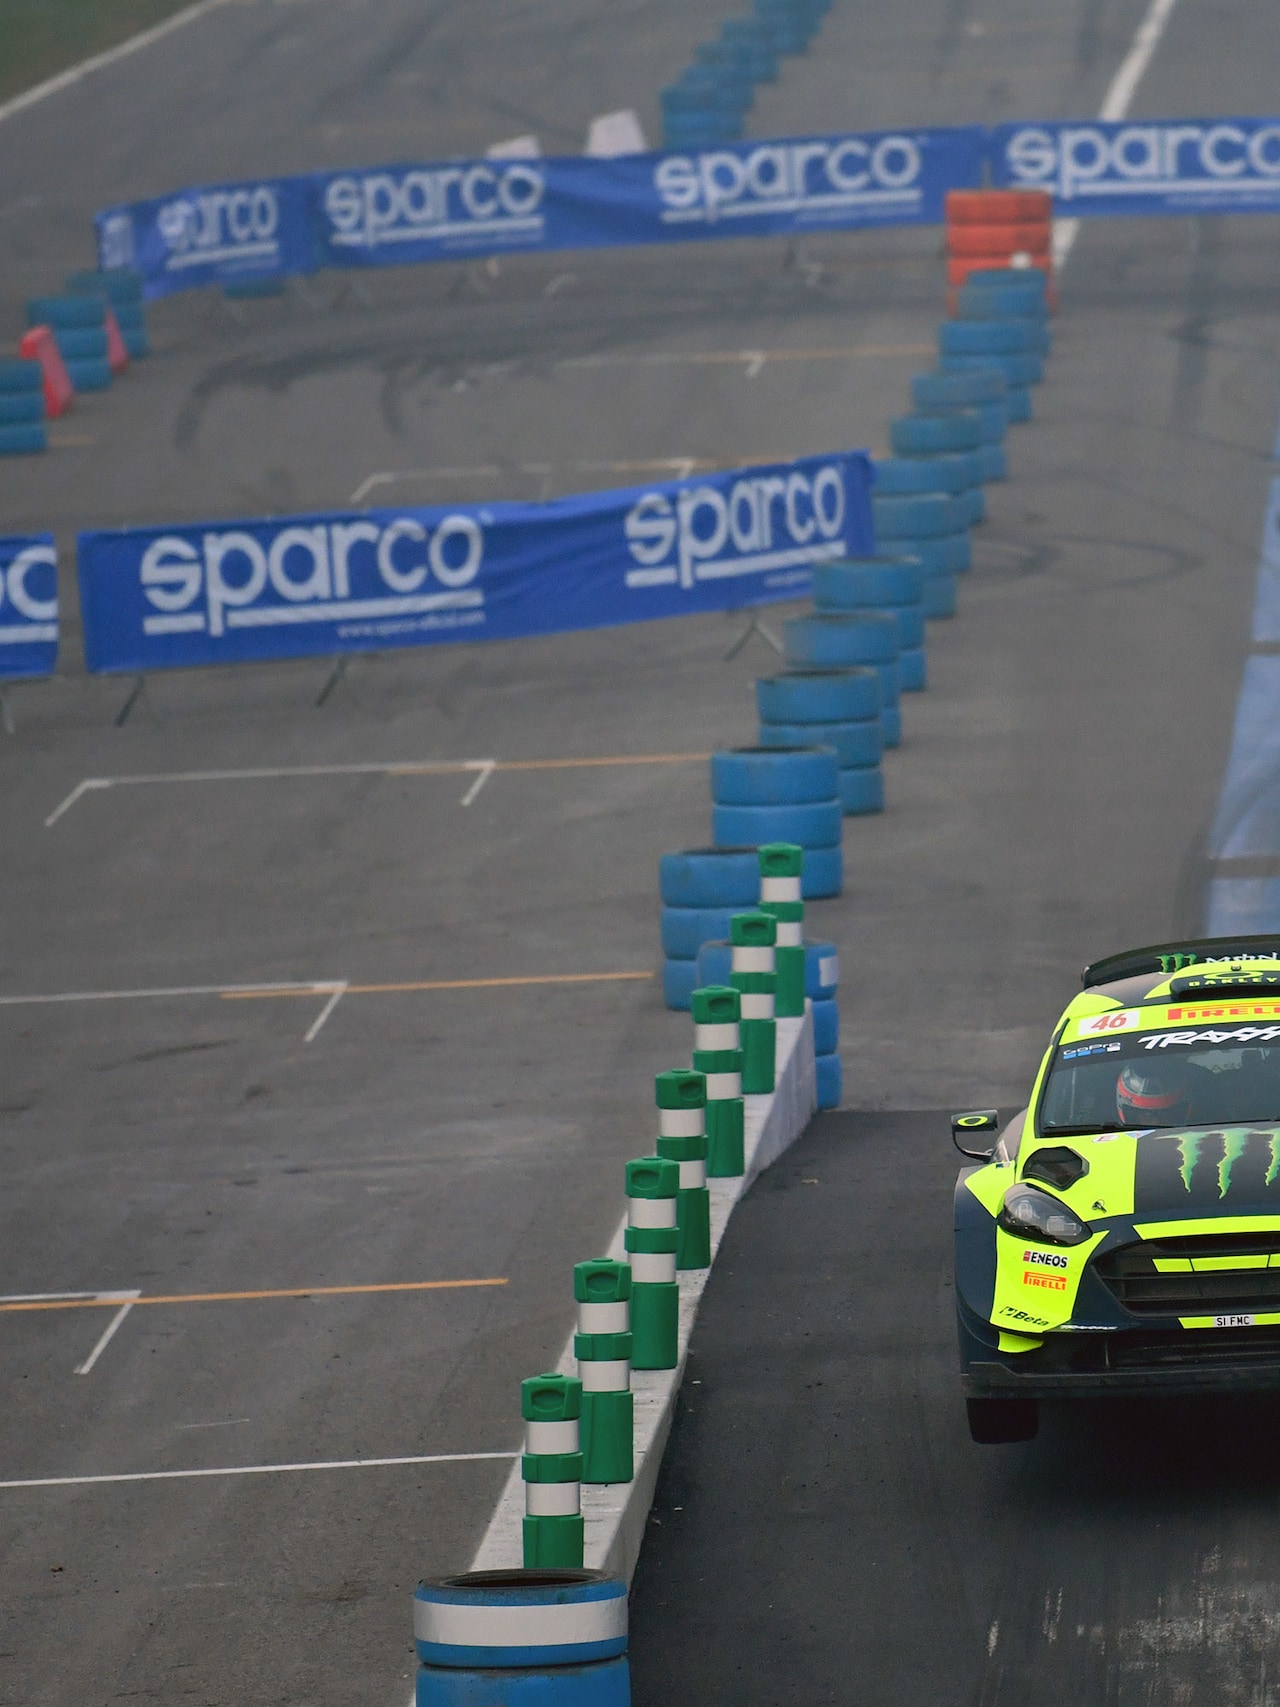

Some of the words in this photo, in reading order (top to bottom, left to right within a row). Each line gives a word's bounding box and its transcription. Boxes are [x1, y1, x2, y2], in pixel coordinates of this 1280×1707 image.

[654, 136, 921, 224] sparco
[325, 164, 544, 247] sparco
[624, 465, 847, 589] sparco
[140, 513, 484, 637] sparco
[1188, 976, 1278, 988] OAKLEY
[1091, 1012, 1127, 1031] 46
[1030, 1252, 1068, 1268] ENEOS
[1023, 1271, 1067, 1291] PIRELLI
[1013, 1310, 1050, 1327] Beta
